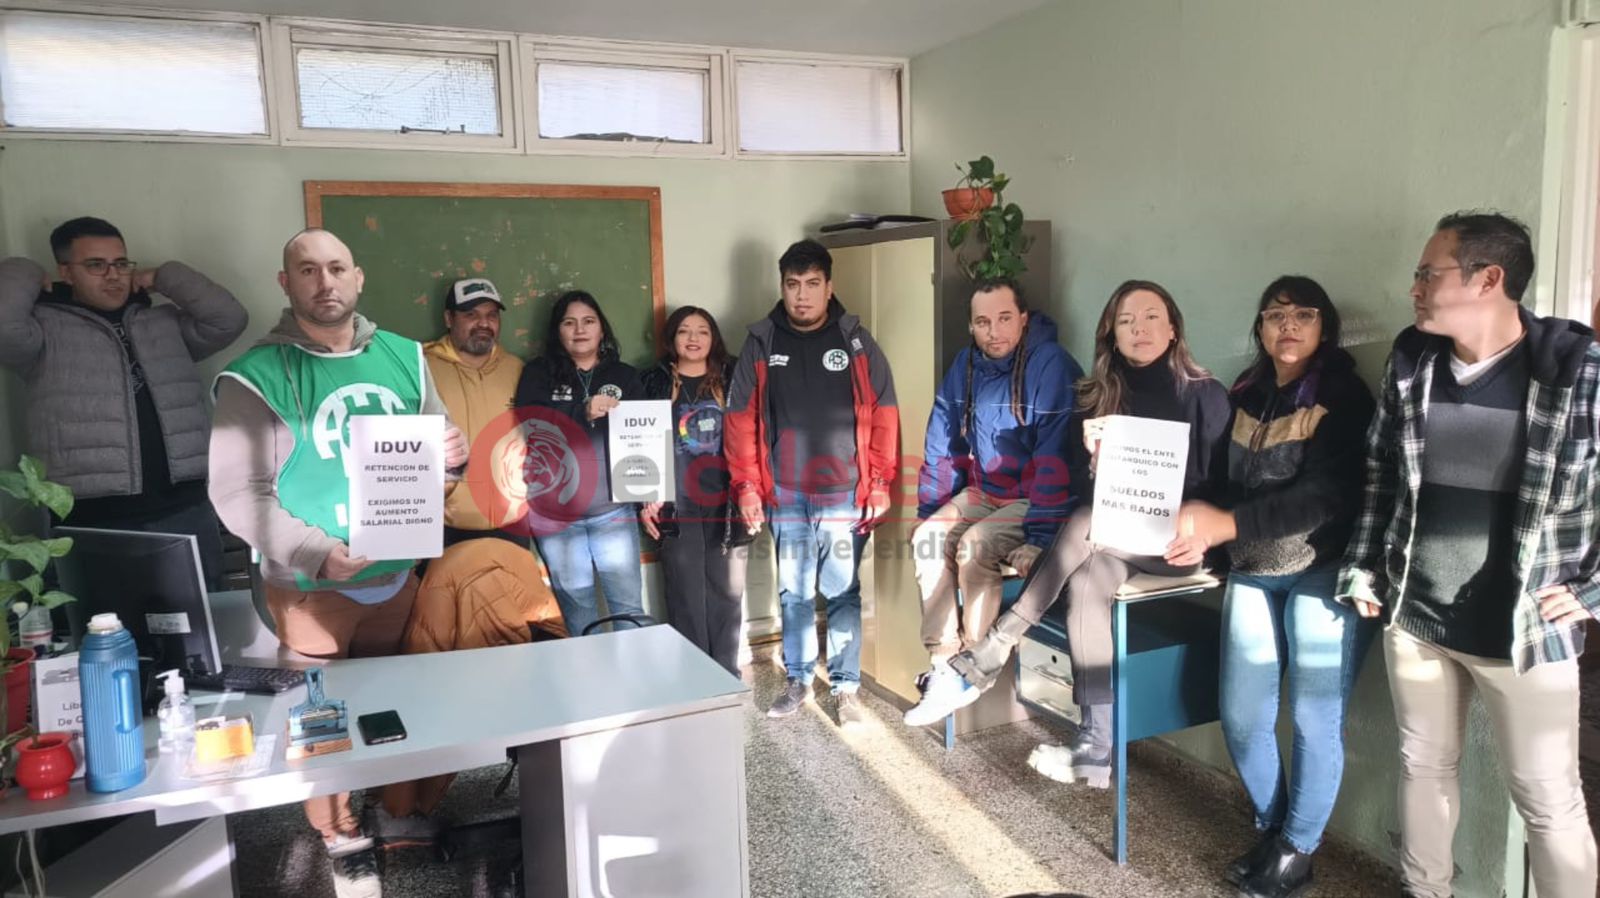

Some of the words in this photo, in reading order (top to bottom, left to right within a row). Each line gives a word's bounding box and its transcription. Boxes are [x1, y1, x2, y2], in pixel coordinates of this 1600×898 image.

[624, 417, 657, 427] IDUV
[374, 441, 423, 454] IDUV
[1153, 449, 1176, 459] ENTE
[364, 464, 415, 472] RETENCION
[1160, 462, 1180, 470] CON
[1132, 468, 1149, 476] LOS
[1110, 485, 1166, 501] SUELDOS
[375, 508, 419, 516] AUMENTO
[1101, 498, 1127, 511] MAS
[1129, 504, 1171, 518] BAJOS
[360, 518, 403, 527] SALARIAL
[405, 517, 434, 525] DIGNO
[57, 719, 73, 727] De
